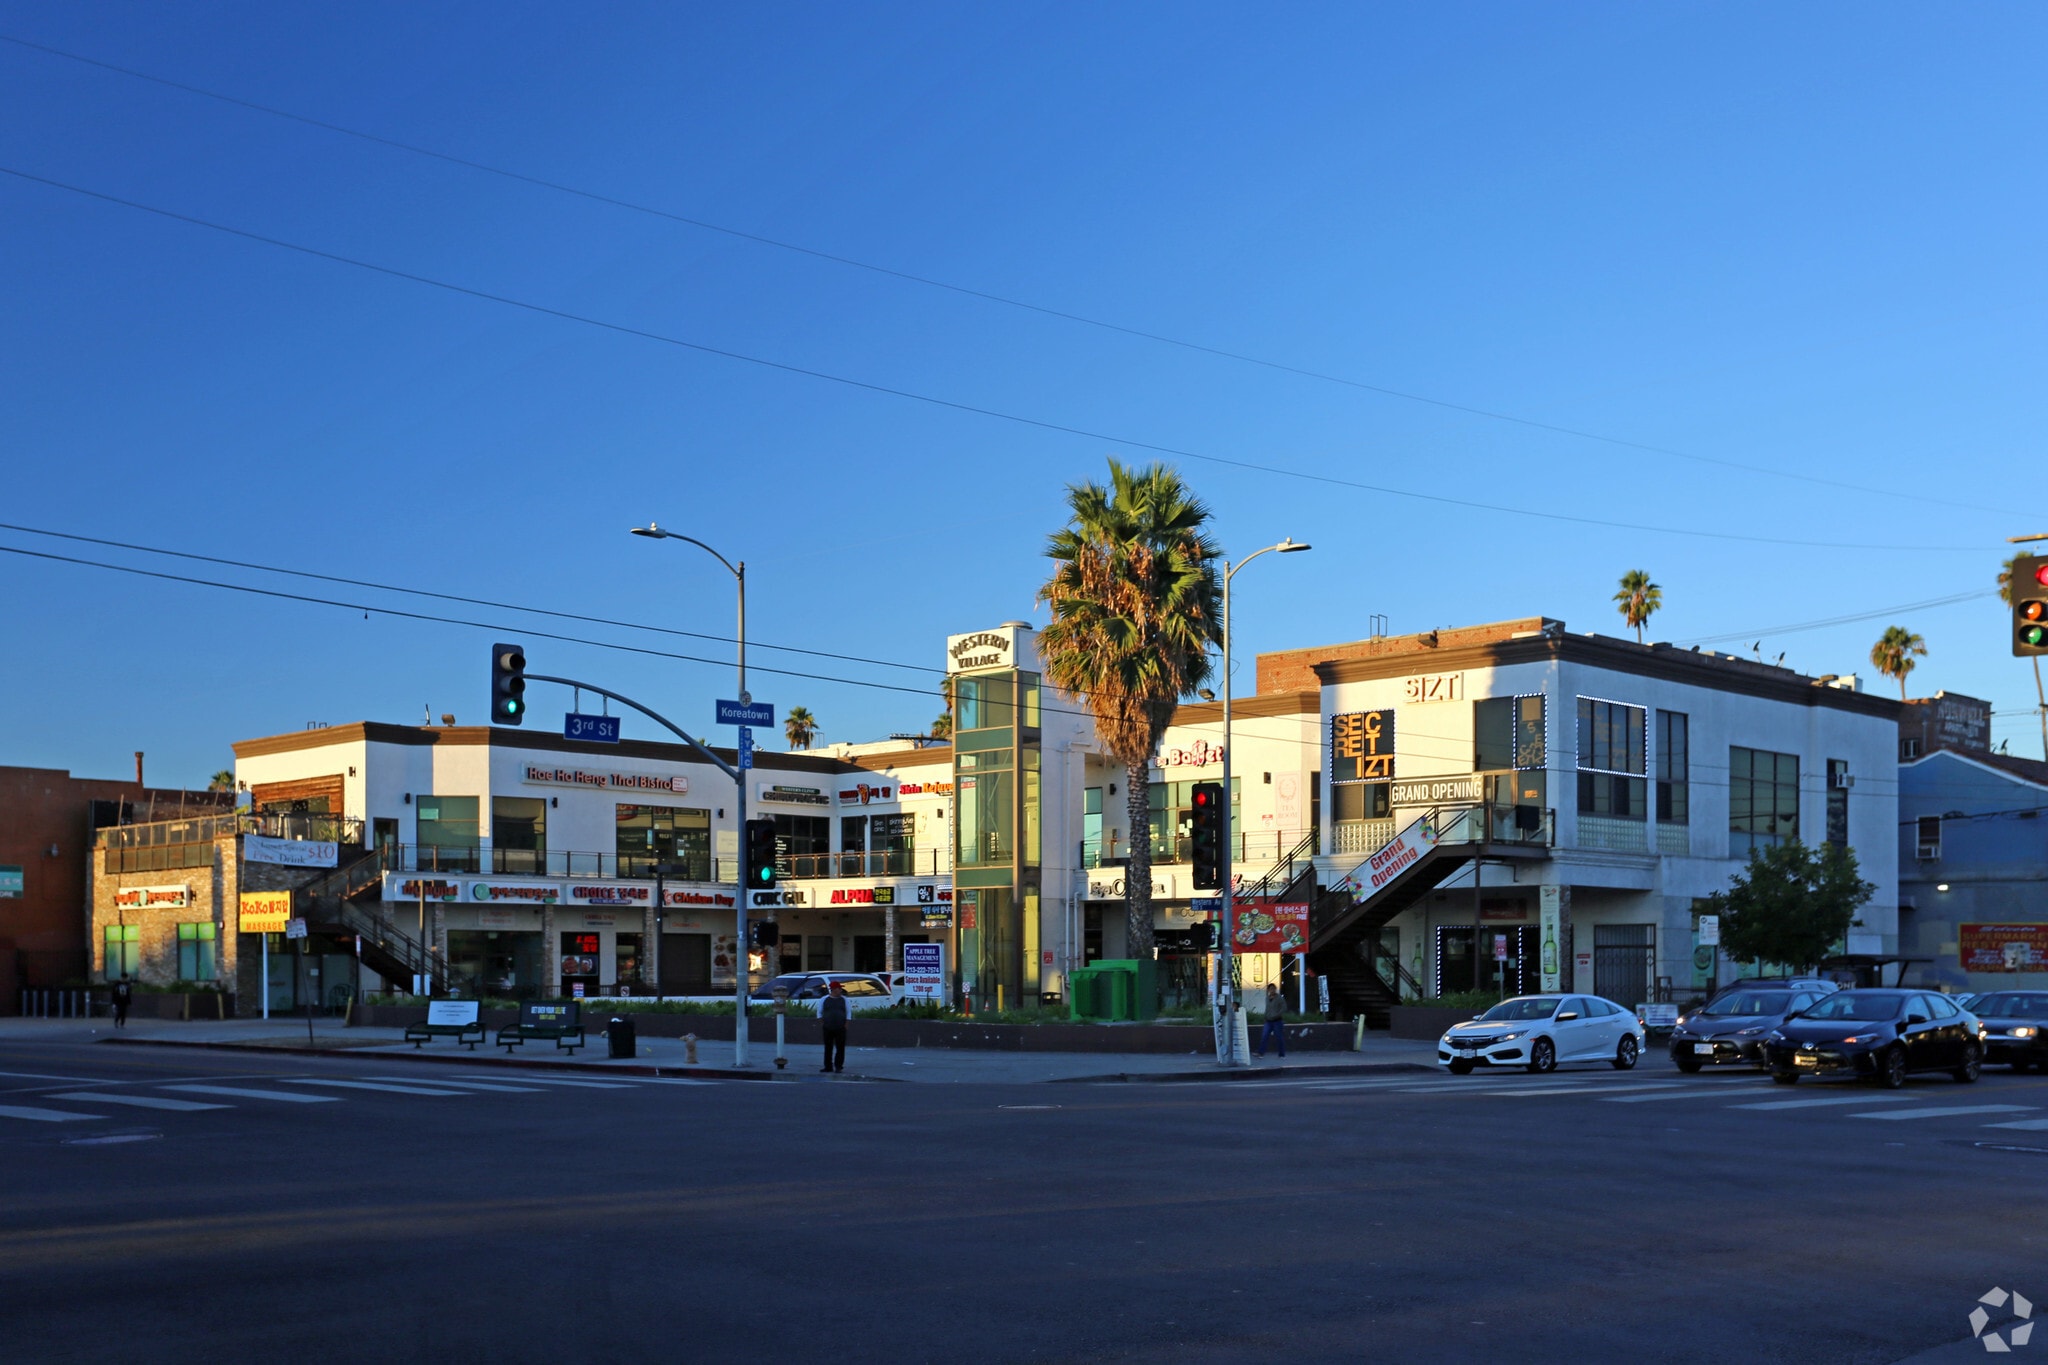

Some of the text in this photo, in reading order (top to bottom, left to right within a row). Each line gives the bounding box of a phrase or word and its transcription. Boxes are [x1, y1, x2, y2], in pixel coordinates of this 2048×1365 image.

[949, 634, 1010, 659] WESTERN
[958, 653, 1001, 668] VILLAGE
[721, 706, 769, 720] Koreatown
[572, 718, 613, 736] 3rd St
[744, 729, 752, 767] SYNC
[528, 767, 553, 781] Hae
[575, 771, 607, 787] Heng
[611, 774, 637, 787] Thai
[639, 776, 672, 790] Bistro
[1392, 781, 1482, 801] GRAND OPENING
[308, 845, 335, 859] $10
[1370, 838, 1405, 870] Grand
[1371, 847, 1418, 887] Opening
[573, 886, 615, 899] CHOICE
[830, 889, 874, 903] ALPHA
[246, 922, 283, 931] MASSAGE
